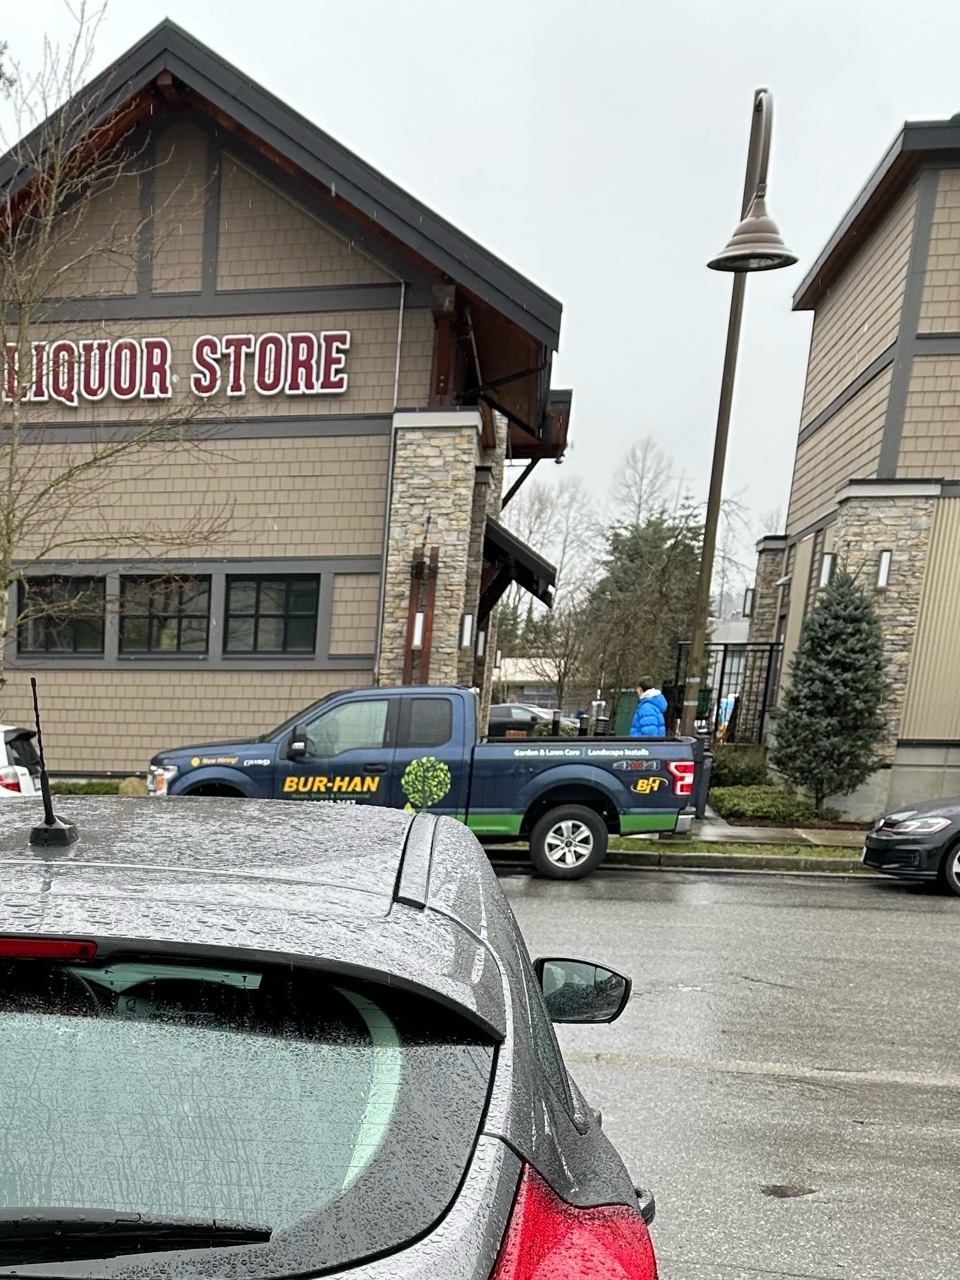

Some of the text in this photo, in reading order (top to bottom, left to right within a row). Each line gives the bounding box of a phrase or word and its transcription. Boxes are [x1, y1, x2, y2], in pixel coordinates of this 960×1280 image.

[3, 330, 352, 407] LIQUOR STORE
[514, 749, 539, 757] Garden
[545, 749, 564, 757] Lawn
[564, 749, 581, 757] Care
[587, 748, 650, 757] Landscape Installs
[283, 776, 380, 793] BUR-HAN
